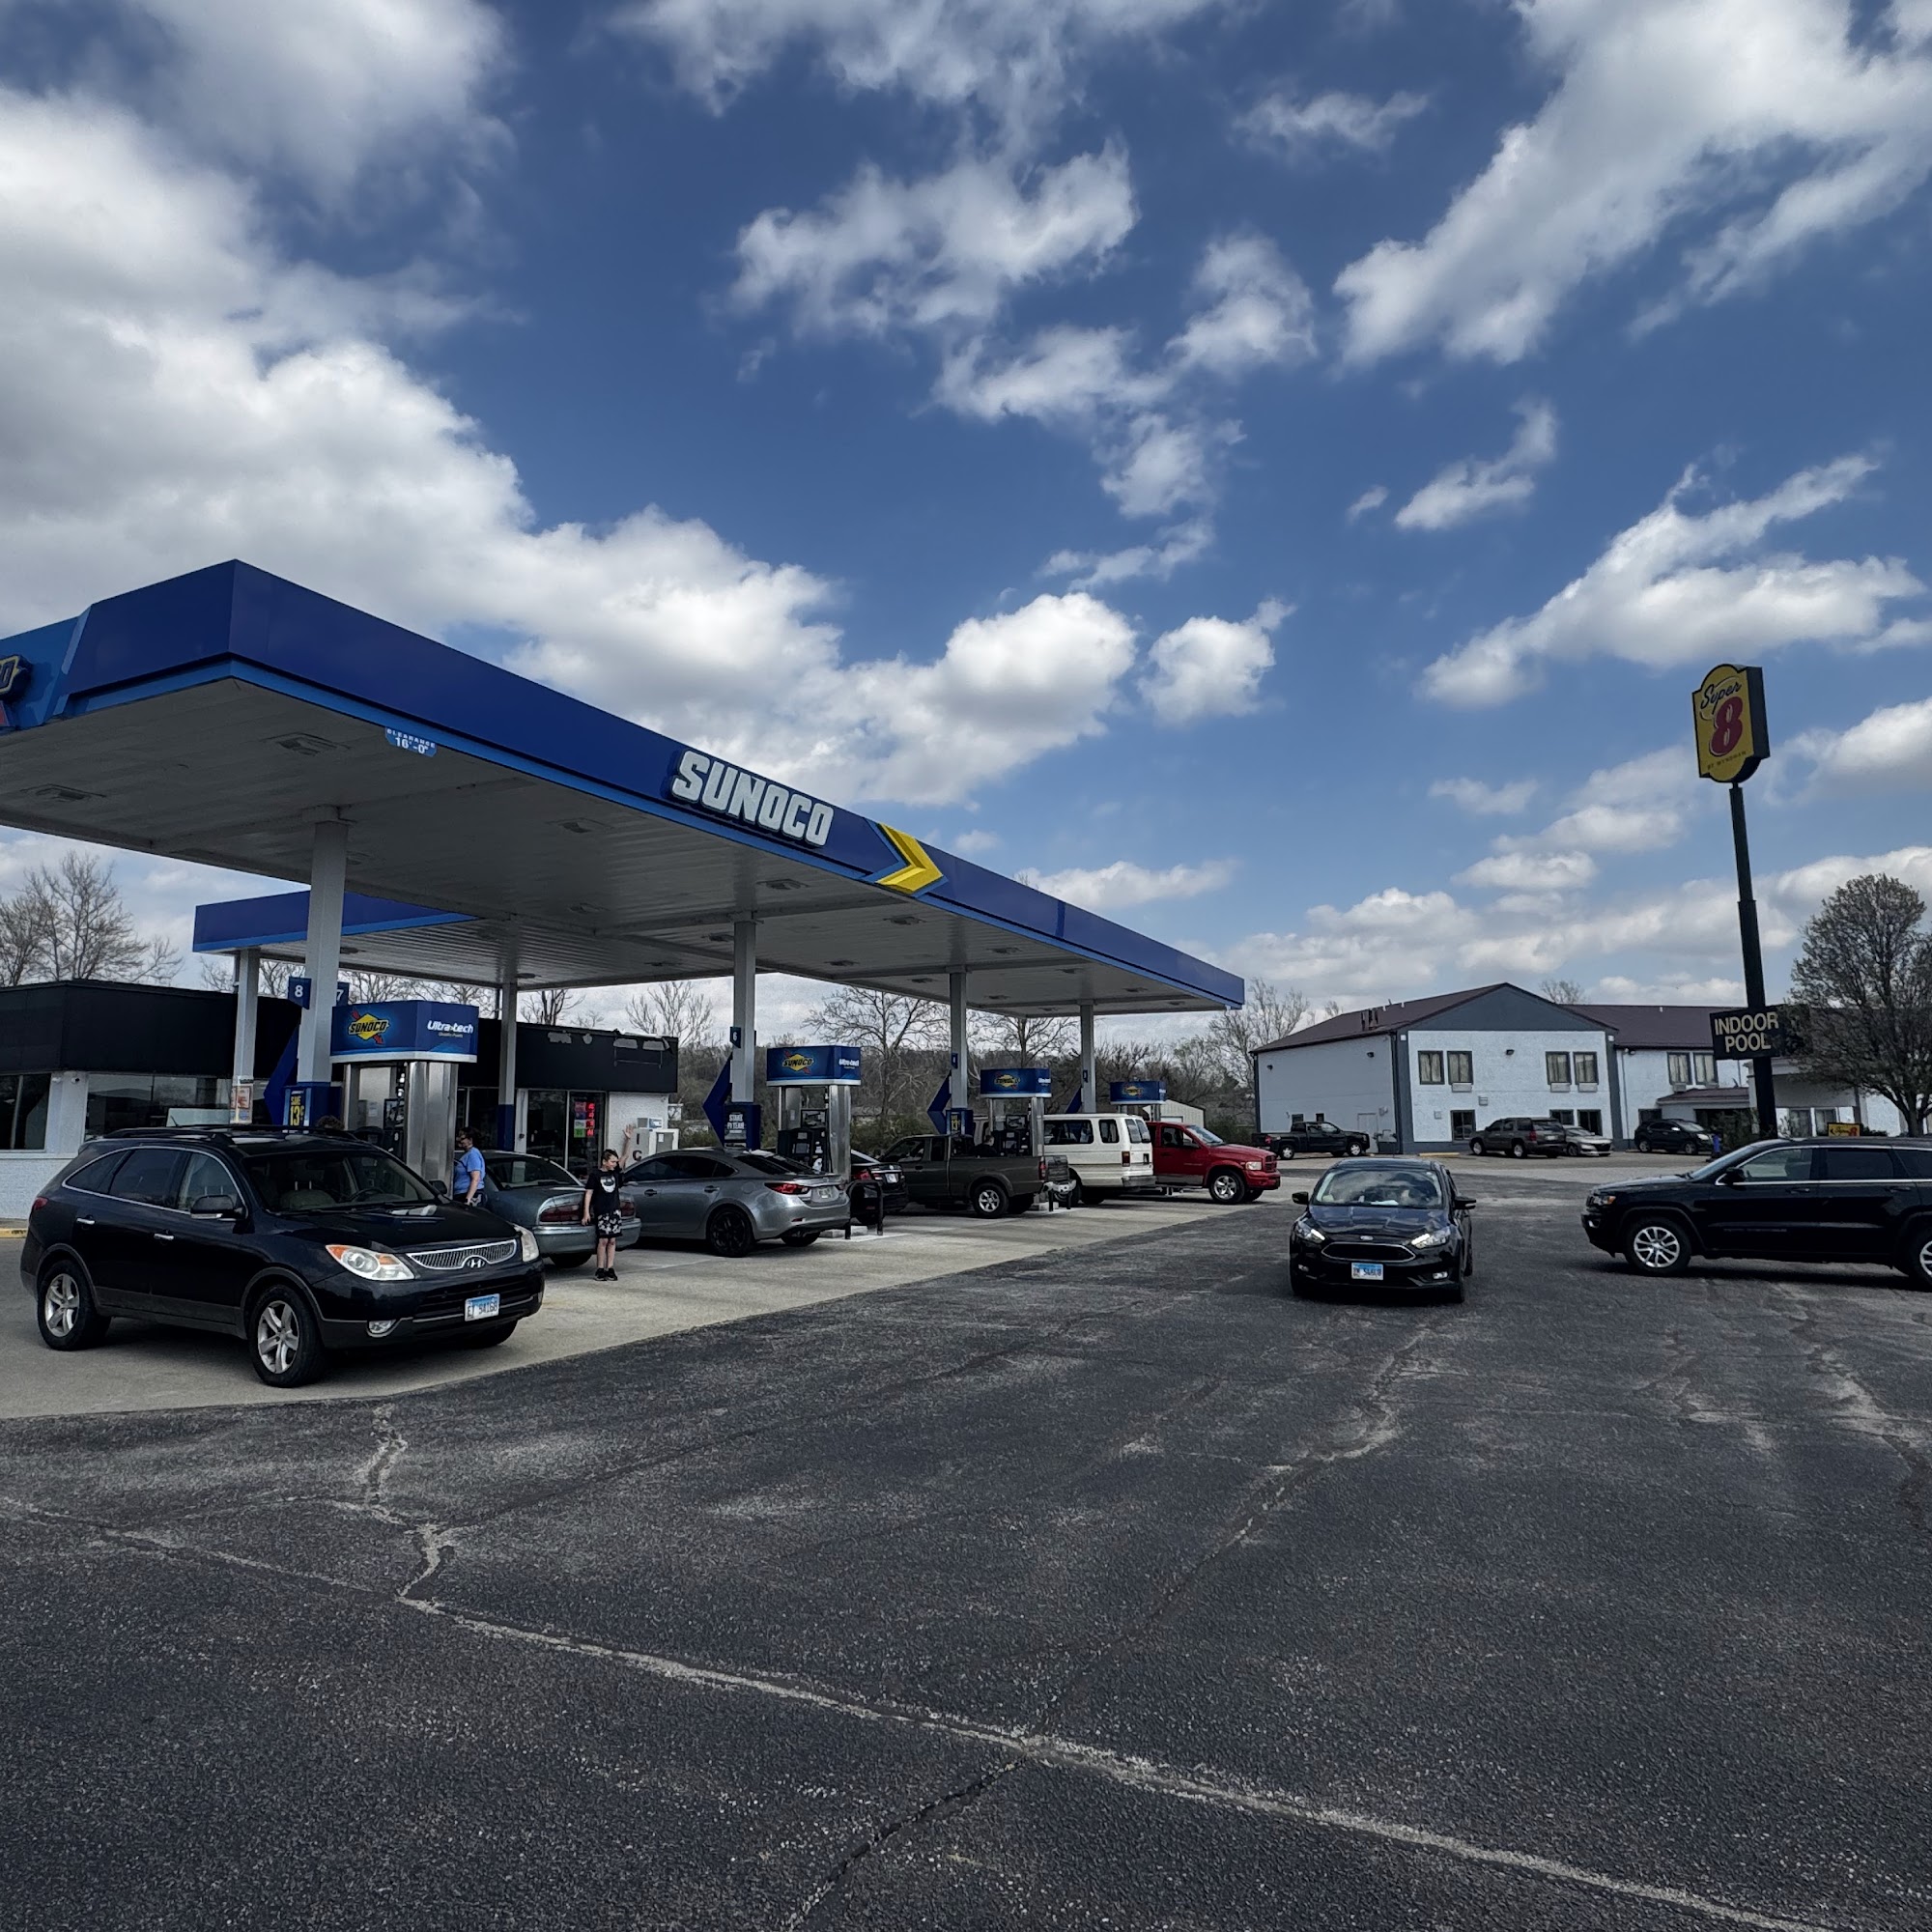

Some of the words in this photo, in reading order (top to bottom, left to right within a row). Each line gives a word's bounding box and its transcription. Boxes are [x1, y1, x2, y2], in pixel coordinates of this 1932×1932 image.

[1700, 682, 1742, 715] Super
[1709, 696, 1744, 757] 8
[386, 728, 436, 749] CLEARANCE
[672, 750, 834, 846] SUNOCO
[294, 984, 304, 998] 8
[336, 988, 345, 1002] 7
[349, 1020, 388, 1034] SUNOCO
[1714, 1010, 1779, 1036] INDOOR
[732, 1031, 738, 1042] 6
[1724, 1032, 1772, 1053] POOL
[782, 1057, 813, 1067] SUNOCO
